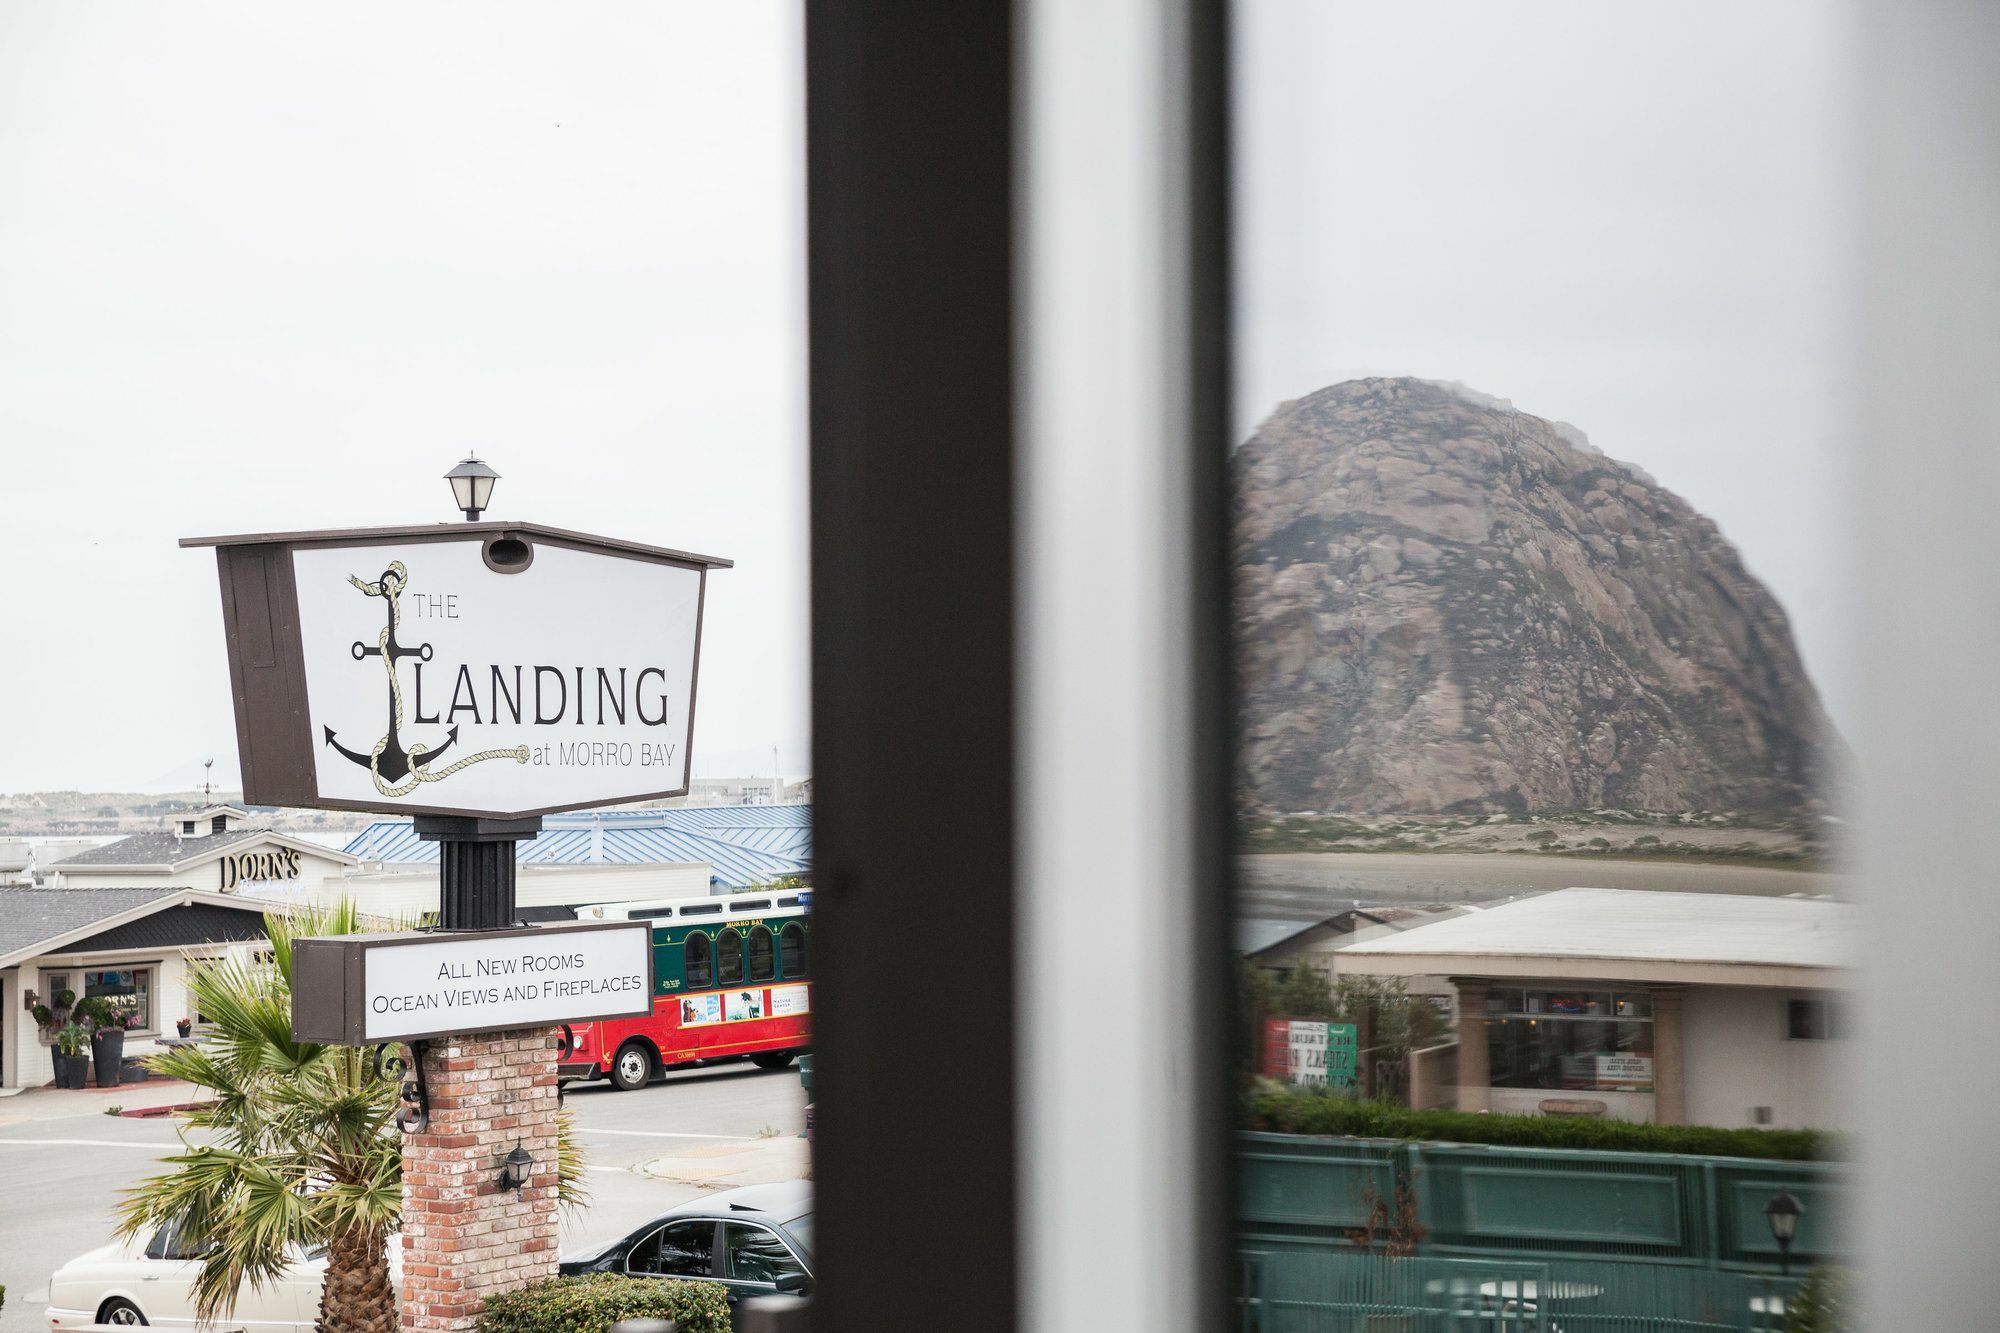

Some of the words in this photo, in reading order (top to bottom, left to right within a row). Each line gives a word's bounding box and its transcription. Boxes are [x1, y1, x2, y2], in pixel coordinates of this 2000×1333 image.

[413, 593, 459, 619] THE
[413, 662, 669, 726] LANDING
[533, 743, 551, 766] at
[559, 742, 633, 766] MORRO
[640, 743, 676, 767] BAY
[219, 848, 302, 893] DORN'S
[437, 962, 472, 980] ALL
[477, 958, 518, 977] NEW
[522, 953, 585, 973] ROOMS
[103, 993, 137, 1006] ORN'S
[372, 993, 438, 1014] OCEAN
[443, 988, 499, 1008] VIEWS
[503, 984, 538, 1002] AND
[543, 975, 642, 999] FIREPLACES
